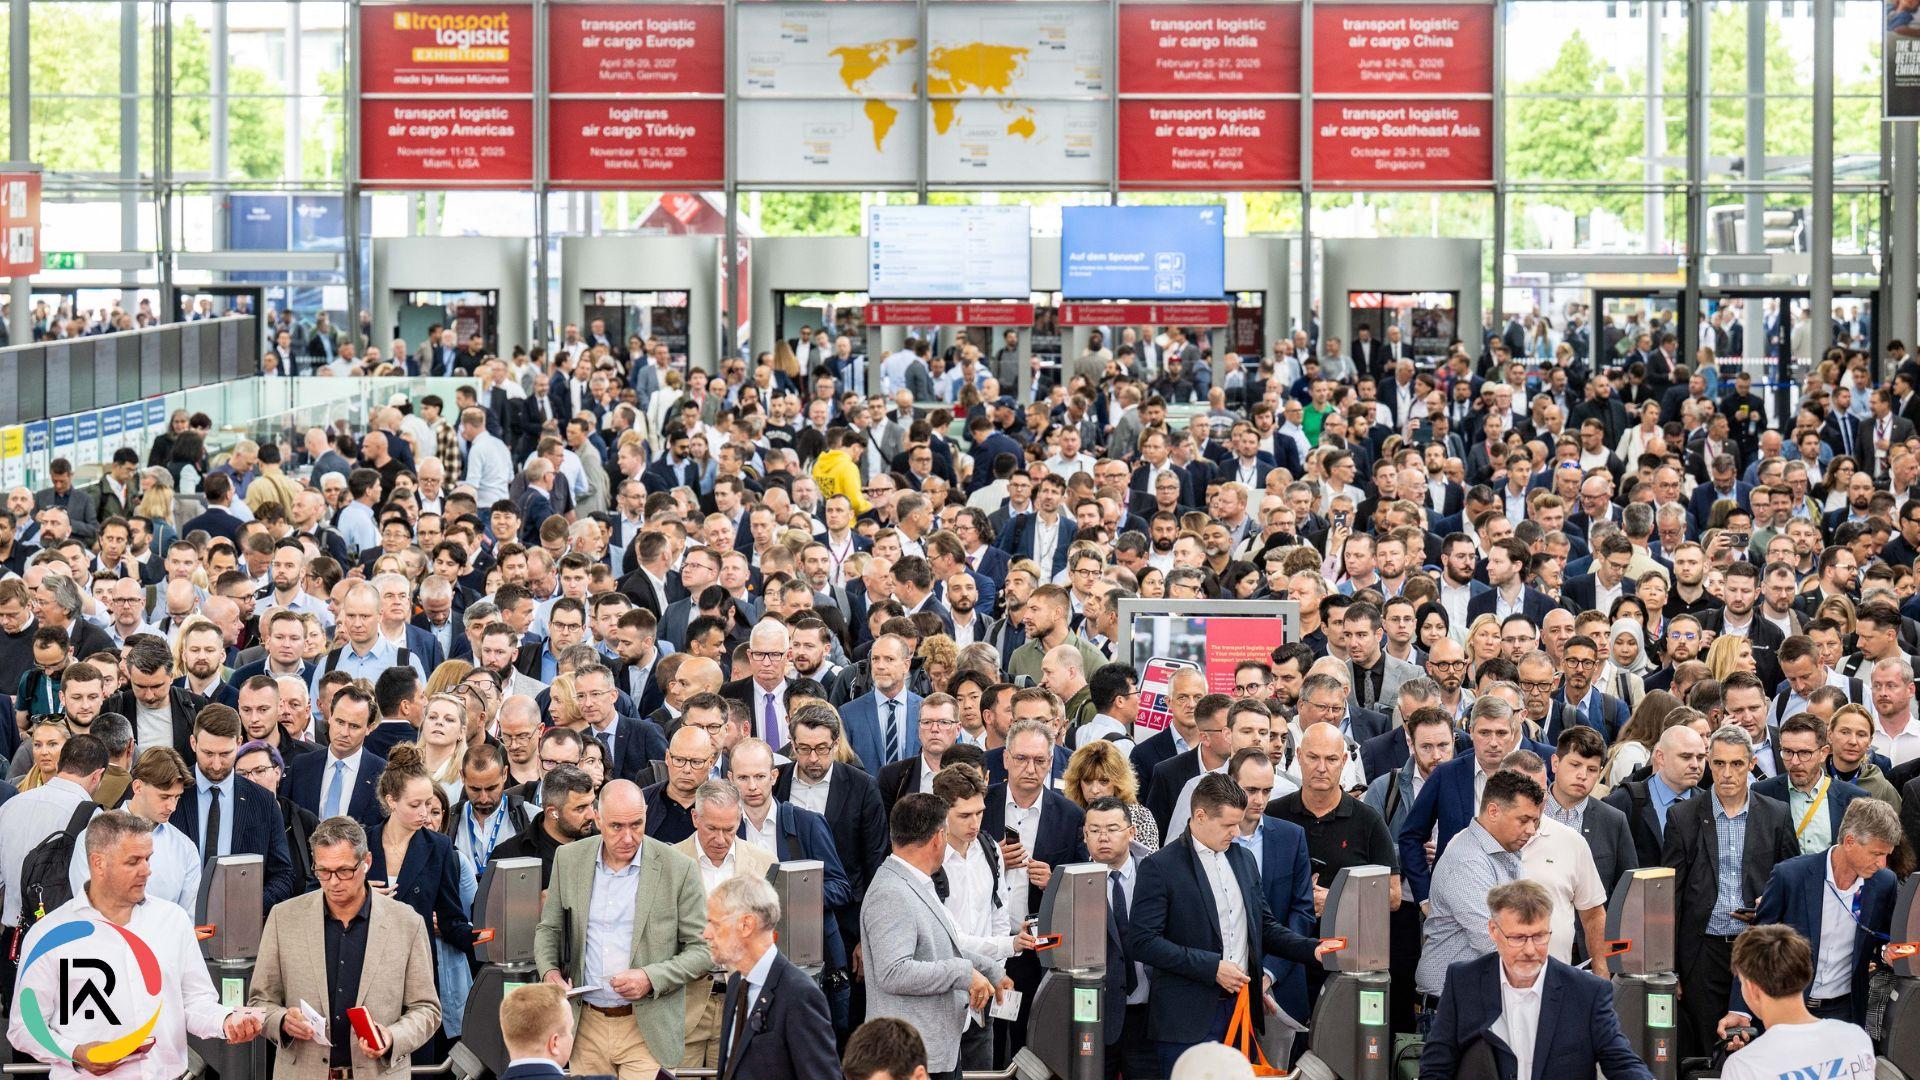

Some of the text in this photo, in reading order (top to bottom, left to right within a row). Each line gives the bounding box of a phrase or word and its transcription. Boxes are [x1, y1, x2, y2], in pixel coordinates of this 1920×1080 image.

[412, 12, 508, 30] transport
[581, 18, 696, 32] transport logistic
[1150, 18, 1266, 32] transport logistic
[1343, 18, 1459, 32] transport logistic
[436, 28, 509, 50] logistic
[582, 34, 695, 50] air cargo Europe
[1159, 34, 1258, 50] air cargo India
[1349, 34, 1454, 50] air cargo China
[1896, 40, 1920, 52] THE W
[416, 49, 504, 60] EXHIBITIONS
[600, 58, 622, 70] April
[654, 58, 677, 68] 2027
[1156, 58, 1200, 70] February
[1235, 58, 1261, 68] 2026
[1358, 58, 1382, 68] June
[1419, 58, 1444, 68] 2026
[599, 70, 678, 82] Munich, Germany
[1174, 70, 1244, 82] Mumbai, India
[1360, 70, 1442, 82] Shanghai, China
[1895, 64, 1920, 76] EMIRA
[394, 74, 509, 86] made by Messe München
[394, 107, 508, 122] transport logistic
[609, 107, 668, 122] logitrans
[1150, 107, 1266, 122] transport logistic
[1342, 107, 1458, 122] transport logistic
[388, 124, 514, 139] air cargo Americas
[582, 124, 696, 139] air cargo Türkiye
[1155, 124, 1260, 139] air cargo Africa
[1320, 124, 1480, 139] air cargo Southeast Asia
[397, 147, 447, 157] November
[480, 147, 505, 157] 2025
[590, 147, 635, 157] November
[664, 147, 687, 157] 2025
[1172, 147, 1244, 159] February 2027
[1350, 147, 1391, 157] October
[1426, 147, 1450, 157] 2025
[423, 158, 480, 170] Miami, USA
[604, 158, 673, 171] Istanbul, Türkiye
[1172, 158, 1244, 171] Nairobi, Kenya
[1375, 158, 1425, 171] Singapore
[1070, 252, 1146, 262] Auf dem Sprung?
[885, 314, 931, 322] Information
[969, 314, 1015, 322] Information
[1079, 314, 1125, 322] Information
[1162, 314, 1209, 322] Information
